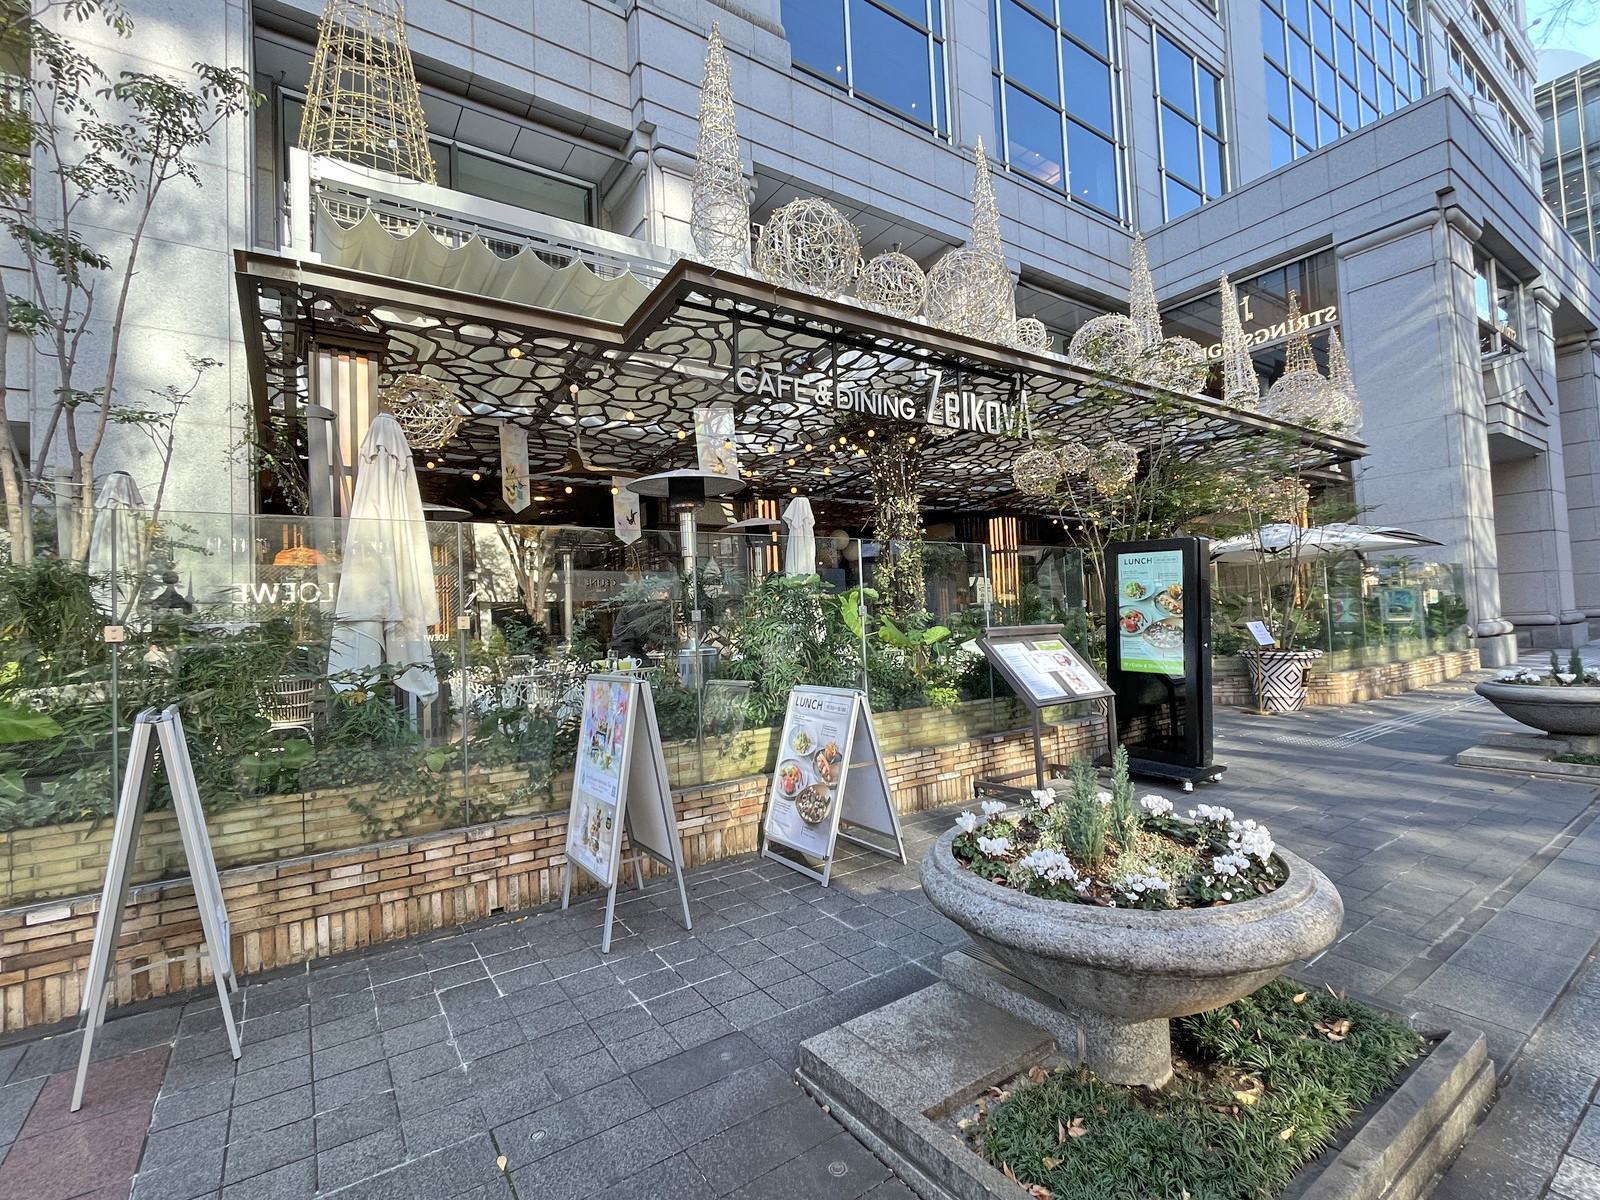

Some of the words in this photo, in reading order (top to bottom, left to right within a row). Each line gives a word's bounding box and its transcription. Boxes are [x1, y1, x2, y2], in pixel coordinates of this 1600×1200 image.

[736, 367, 811, 403] CAFE
[815, 383, 834, 406] &
[836, 385, 916, 420] DINING
[1124, 557, 1153, 565] LUNCH
[795, 696, 824, 711] LUNCH
